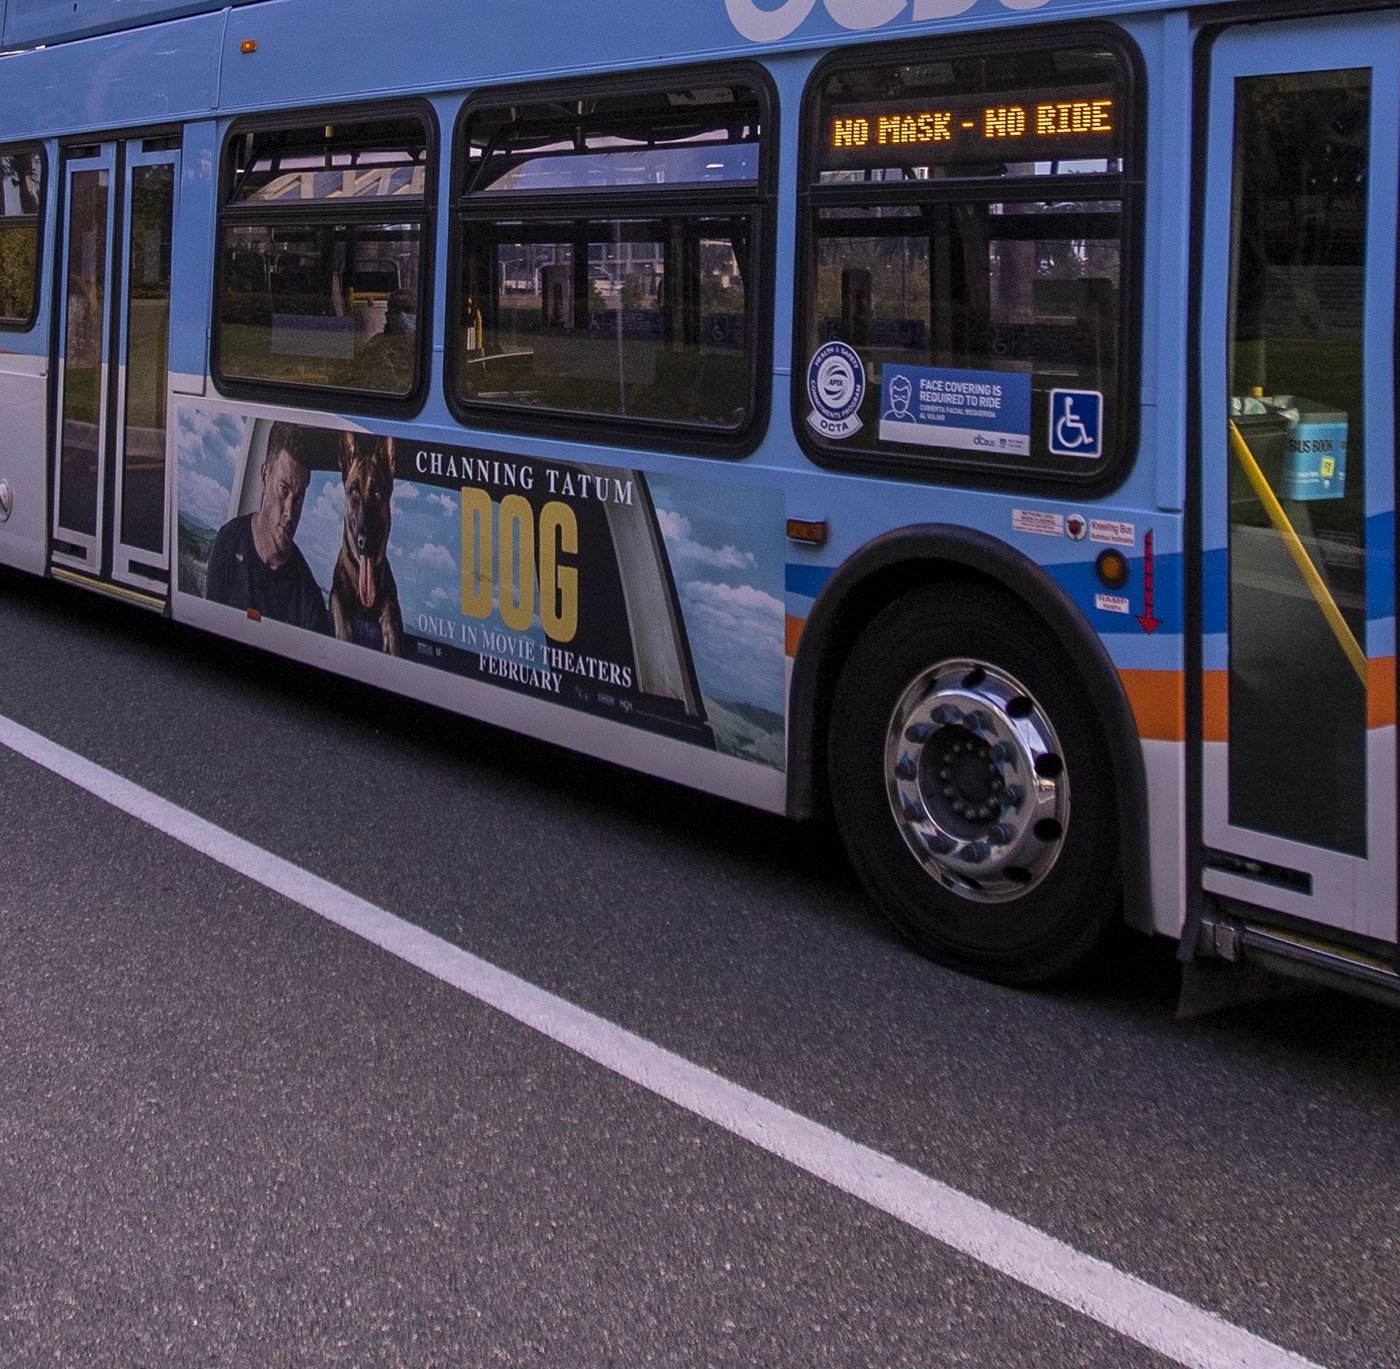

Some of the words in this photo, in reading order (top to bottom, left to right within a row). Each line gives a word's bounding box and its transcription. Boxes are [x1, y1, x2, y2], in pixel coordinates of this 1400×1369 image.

[834, 119, 868, 146] NO
[878, 113, 951, 143] MASK
[985, 107, 1025, 138] NO
[1037, 100, 1112, 134] RIDE
[814, 346, 834, 367] HEALTH
[840, 347, 859, 369] SAFETY
[810, 379, 842, 419] COMMITMENTS
[841, 384, 861, 417] PROGRAM
[920, 379, 944, 392] FACE
[944, 381, 992, 396] COVERING
[992, 385, 1002, 396] IS
[920, 391, 965, 406] REQUIRED
[966, 395, 978, 406] TO
[979, 396, 1001, 409] RIDE
[820, 419, 849, 432] OCTA
[1289, 439, 1311, 453] BUS
[1312, 439, 1334, 452] BOOK
[415, 451, 535, 491] CHANNING
[545, 468, 635, 507] TATUM
[1092, 520, 1119, 535] Kneeling
[1119, 524, 1133, 535] Bus
[460, 486, 578, 643] DOG
[1098, 594, 1127, 605] RAMP
[417, 612, 457, 640] ONLY
[461, 624, 477, 645] IN
[482, 629, 535, 662] MOVIE
[539, 644, 633, 689] THEATERS
[478, 652, 563, 694] FEBRUARY
